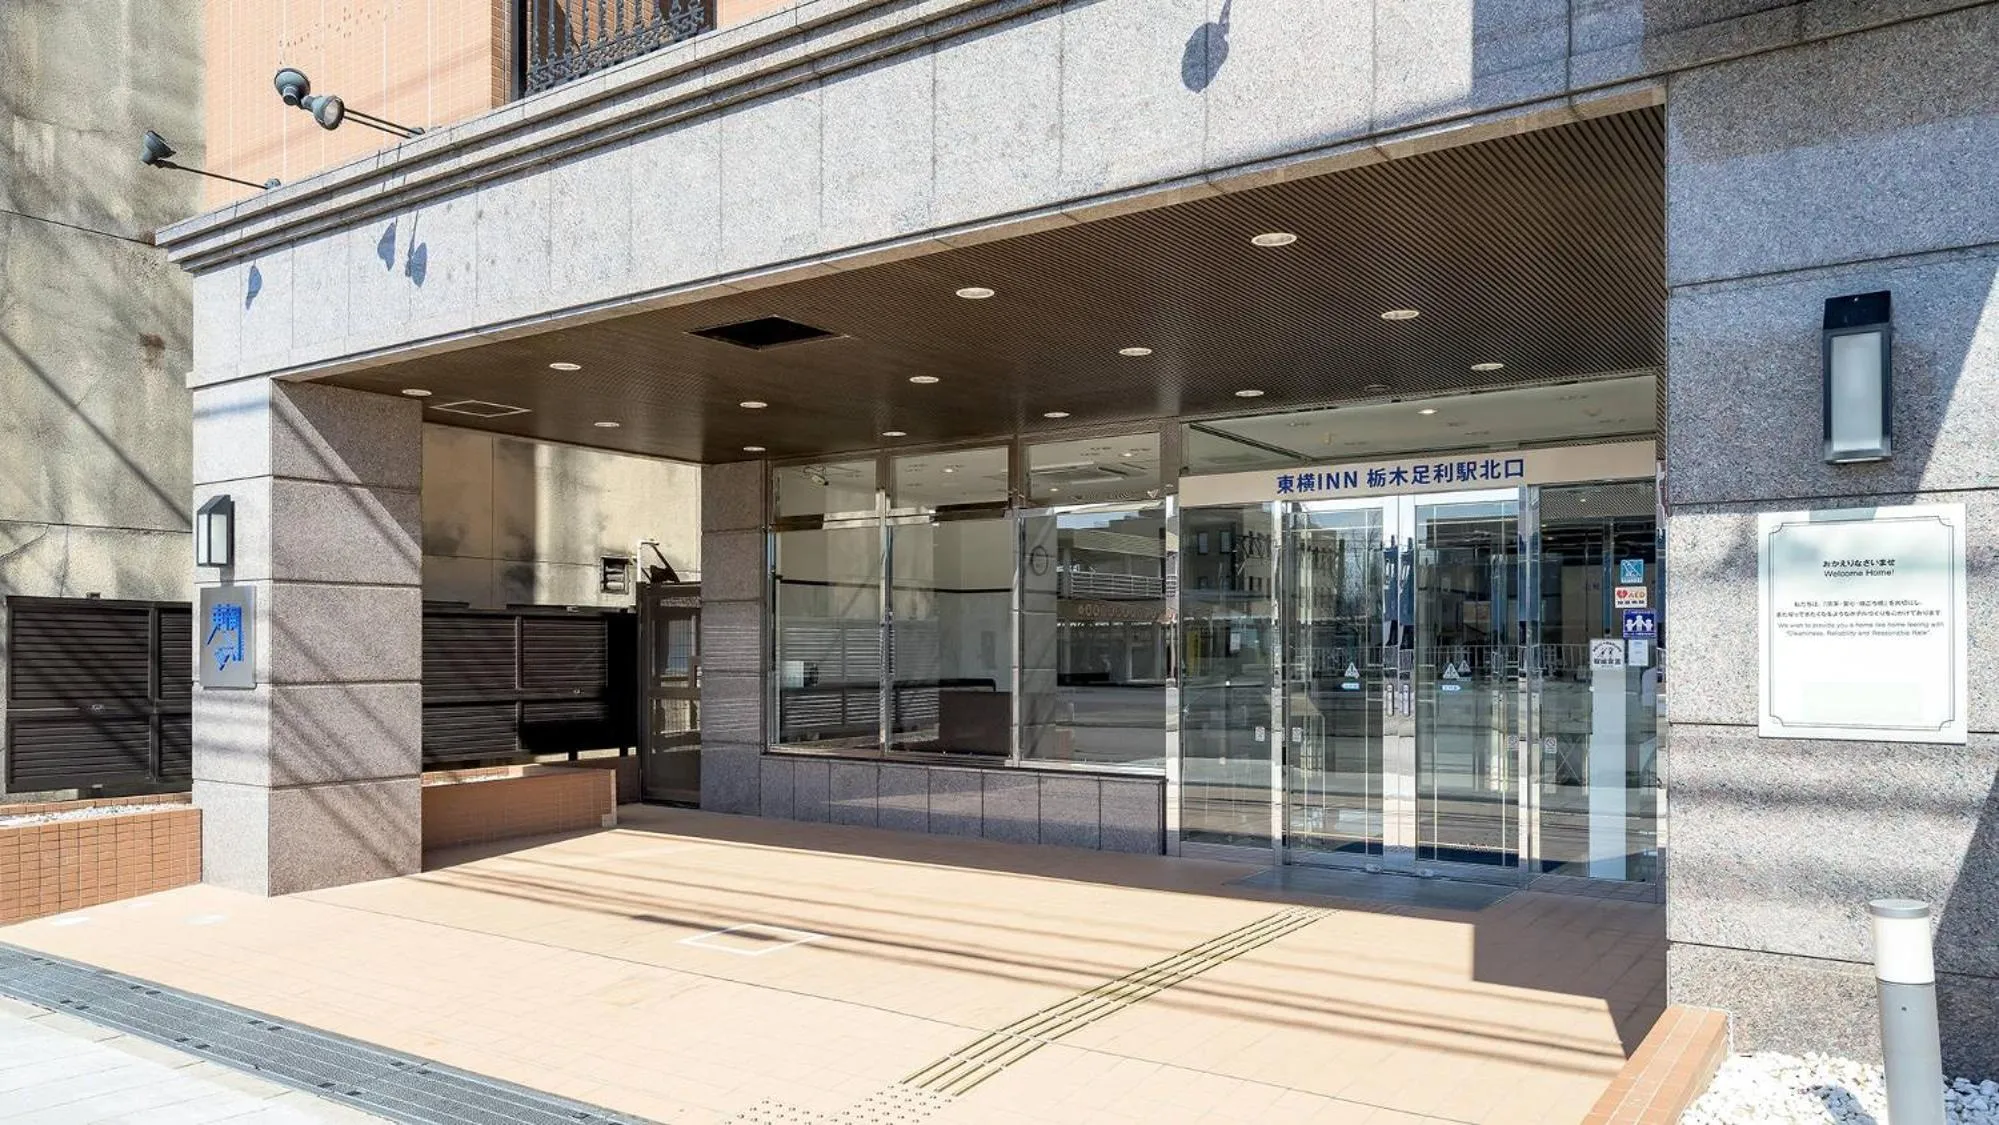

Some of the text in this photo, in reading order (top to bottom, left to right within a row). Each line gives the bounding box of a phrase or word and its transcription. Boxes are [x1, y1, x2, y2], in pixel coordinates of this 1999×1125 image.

[1277, 459, 1525, 495] 東横INN 栃木足利駅北口
[1823, 559, 1896, 568] おかえりなさいませ
[1866, 569, 1895, 577] Home!
